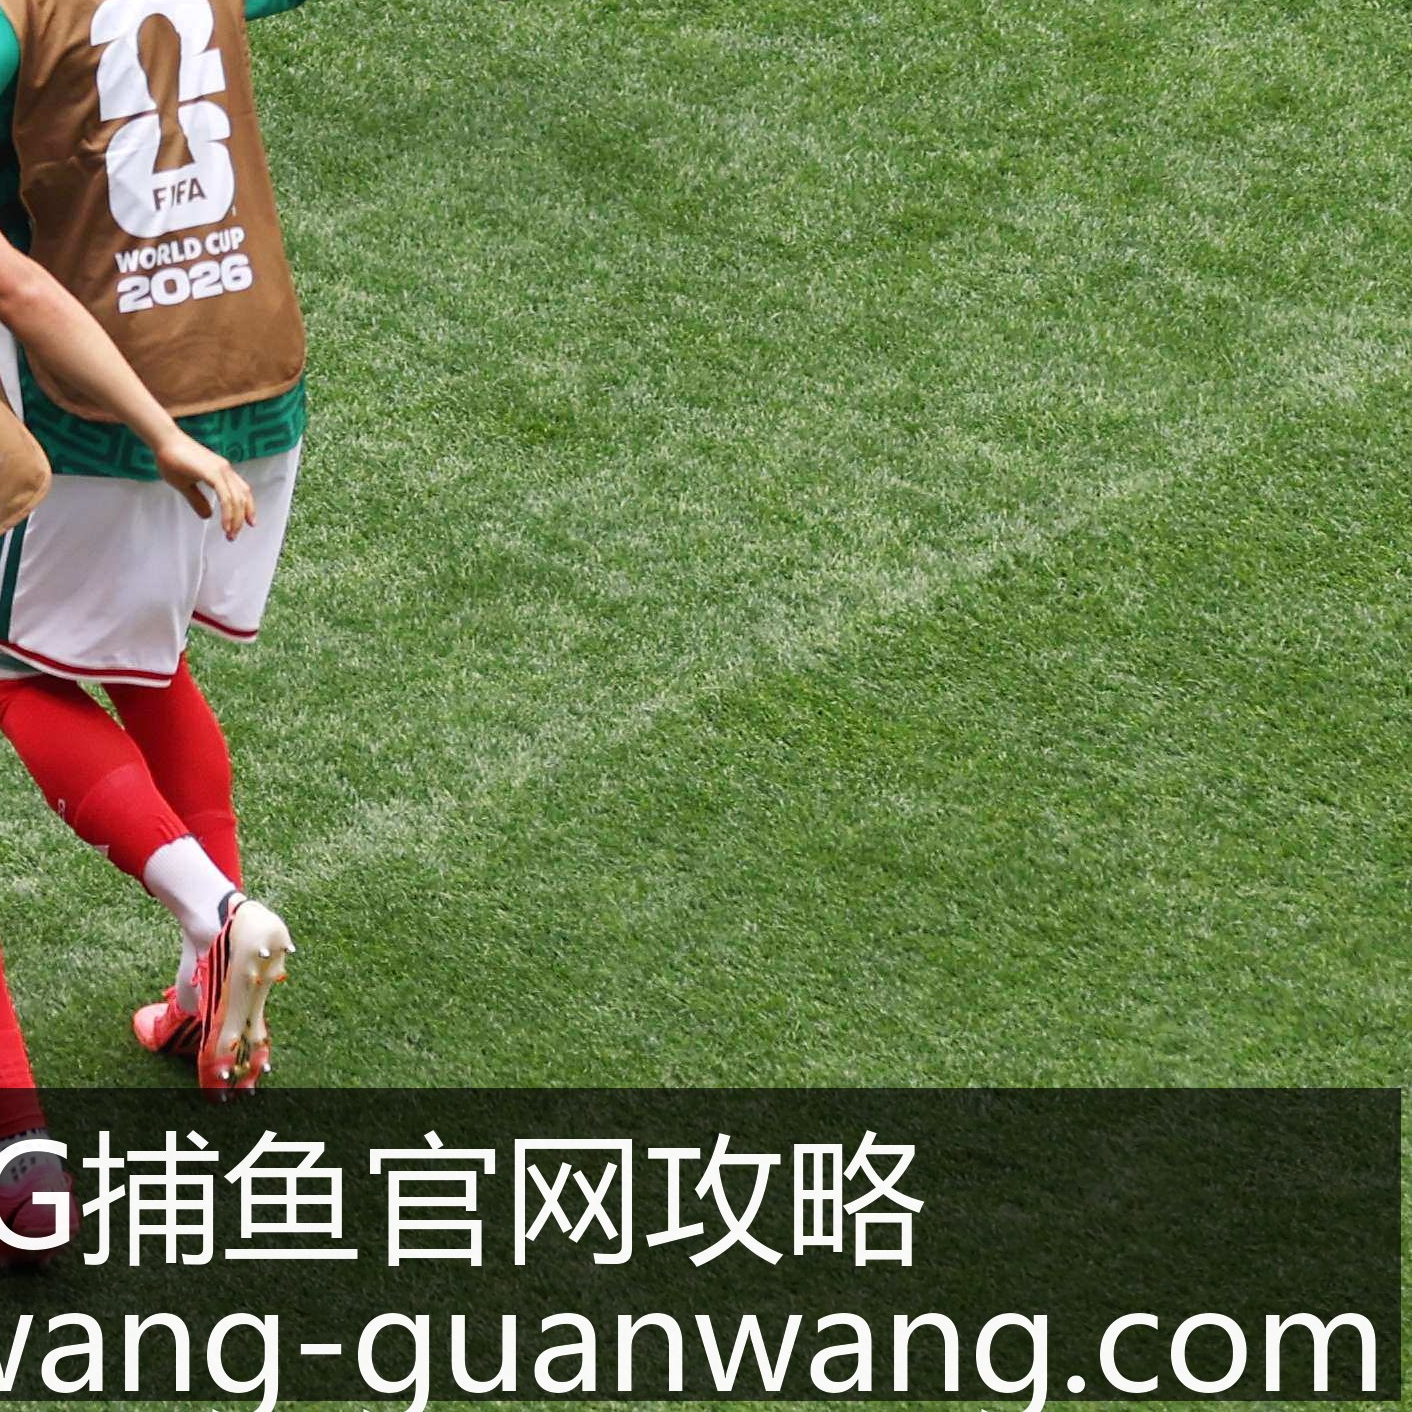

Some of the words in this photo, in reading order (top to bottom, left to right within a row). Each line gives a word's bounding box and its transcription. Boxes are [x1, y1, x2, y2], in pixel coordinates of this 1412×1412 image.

[153, 178, 207, 211] FIFA
[115, 237, 202, 273] WORLD
[205, 227, 245, 255] CUP
[117, 253, 253, 314] 2026
